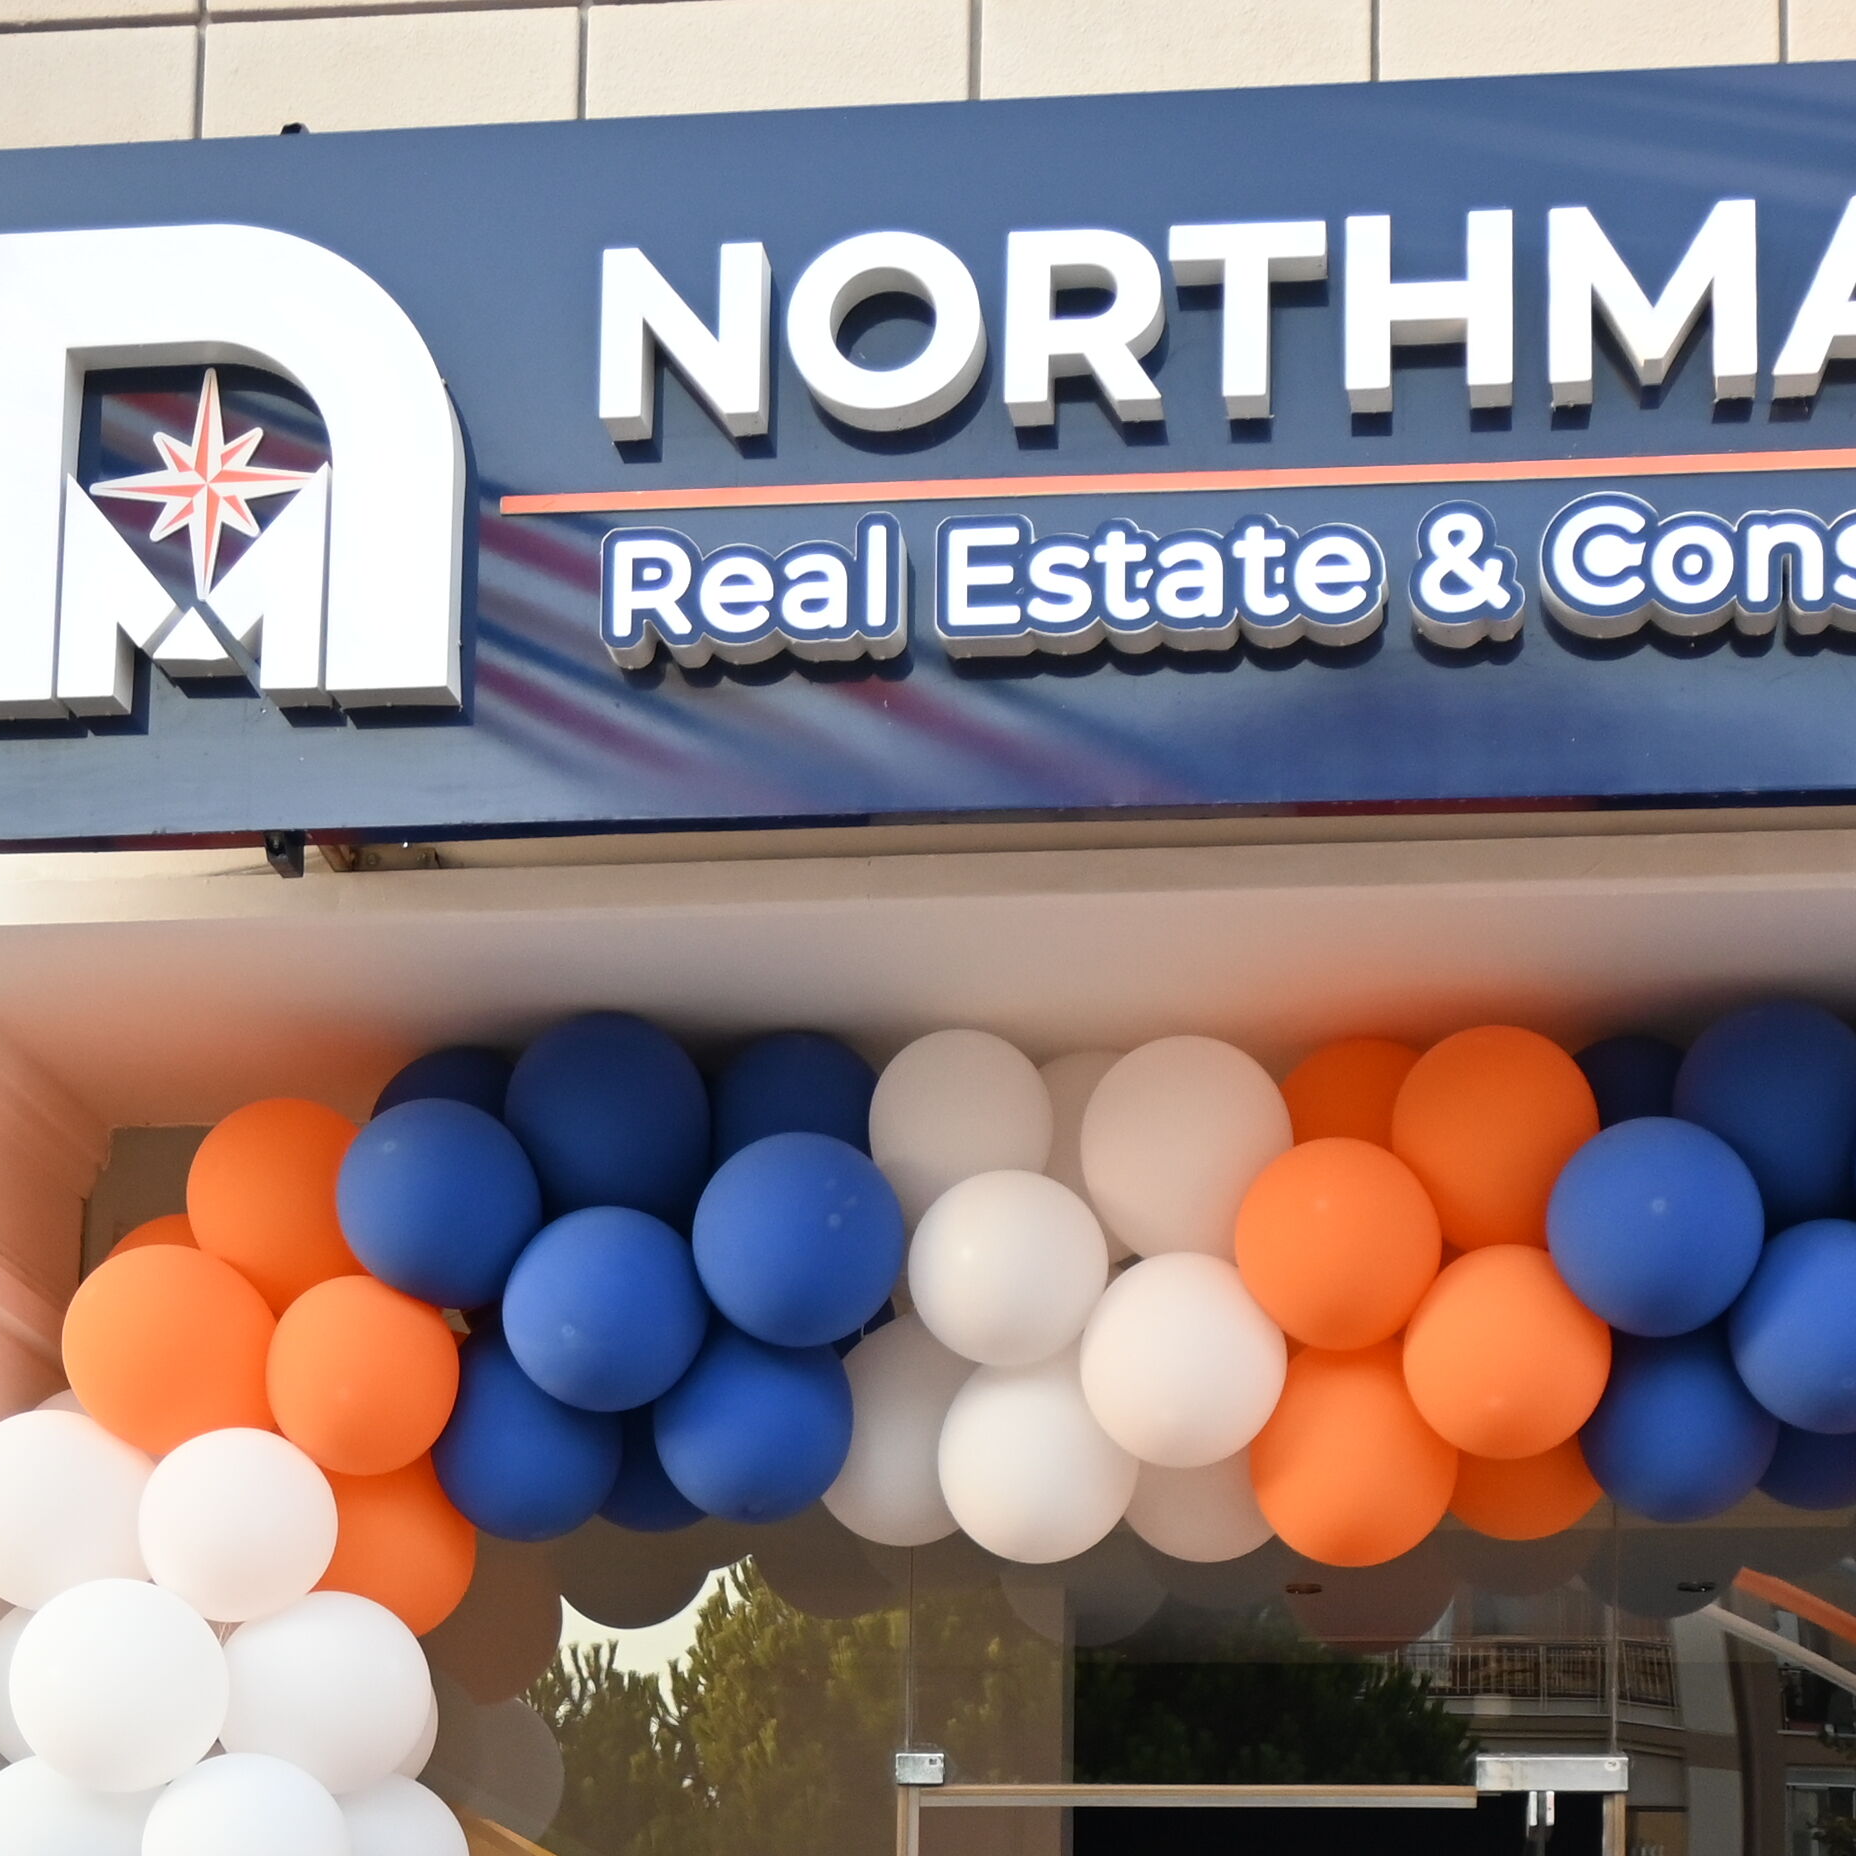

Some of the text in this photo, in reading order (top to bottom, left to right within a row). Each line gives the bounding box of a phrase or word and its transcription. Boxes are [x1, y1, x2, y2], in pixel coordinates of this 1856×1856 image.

[604, 513, 904, 648] Real
[939, 512, 1382, 642] Estate
[1414, 503, 1520, 625] &
